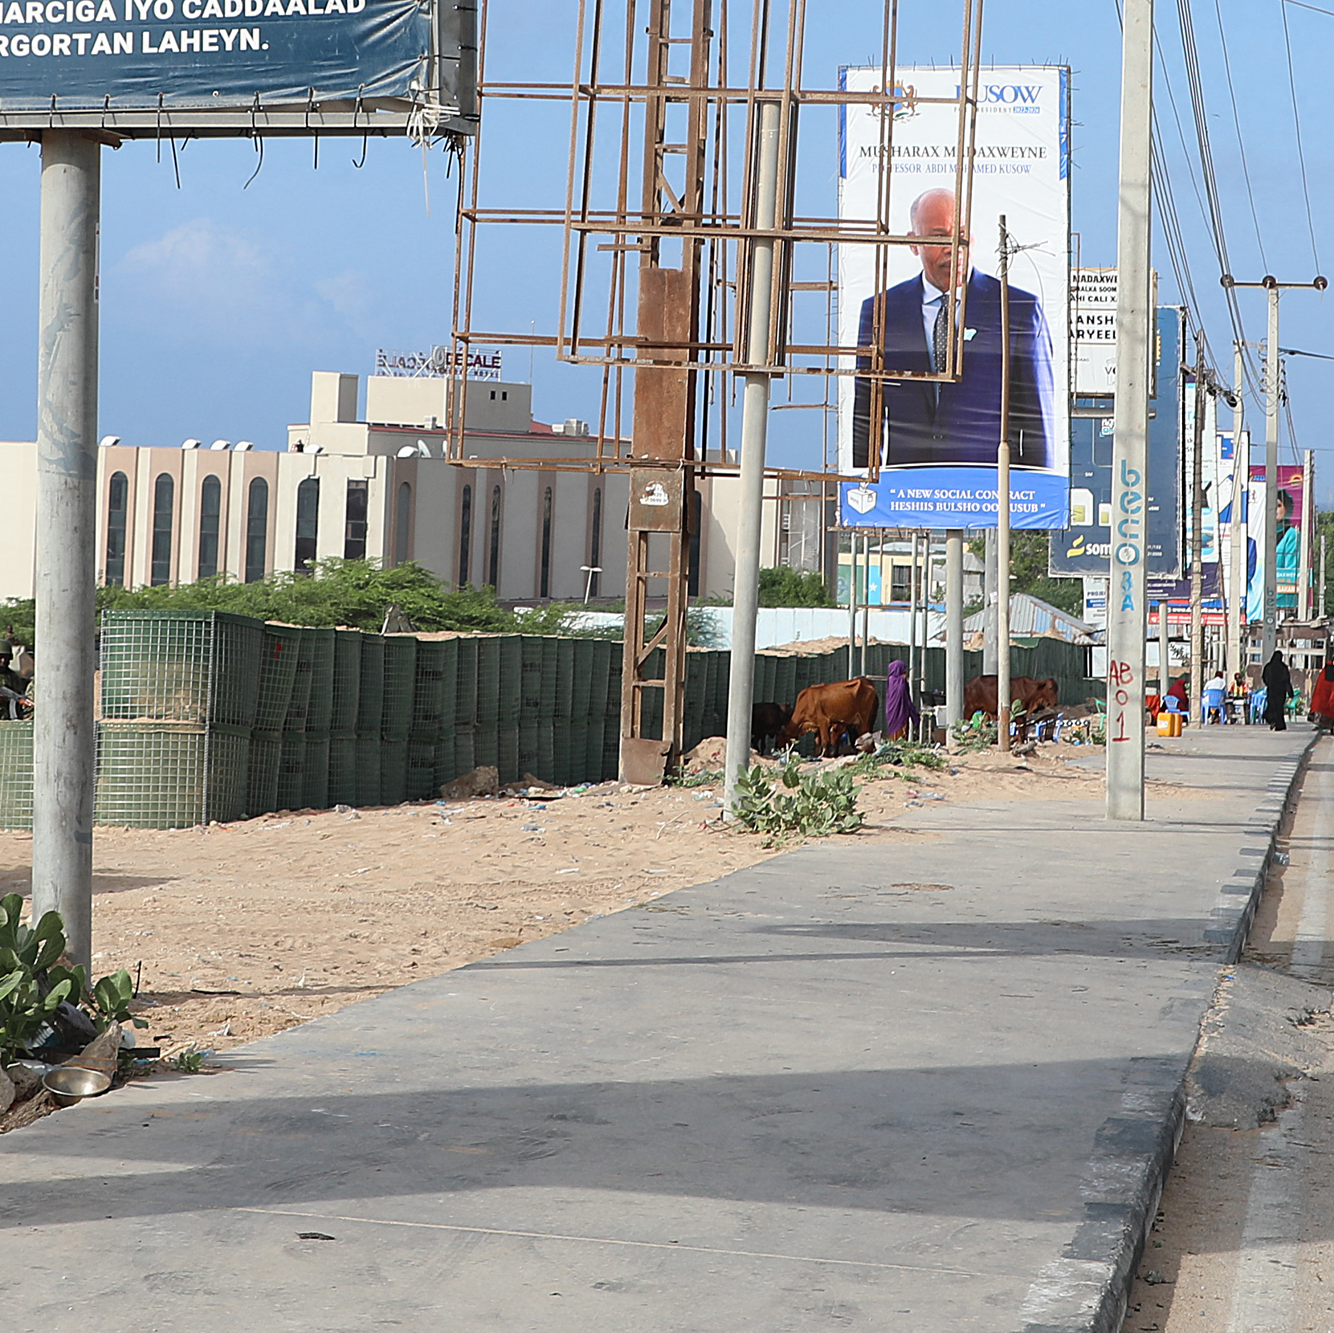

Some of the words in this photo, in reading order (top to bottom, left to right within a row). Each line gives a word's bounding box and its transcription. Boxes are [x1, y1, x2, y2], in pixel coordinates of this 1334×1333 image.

[142, 27, 270, 54] LAHEYN.
[944, 146, 1047, 159] MDAXWEYNE
[925, 164, 947, 173] ABDI
[999, 164, 1031, 174] KUSOW
[897, 489, 906, 499] A
[907, 489, 933, 499] NEW
[934, 489, 974, 500] SOCIAL
[975, 489, 1035, 500] CONRACT
[890, 502, 934, 512] HESHIIS
[936, 502, 980, 513] BULSHO
[1008, 503, 1039, 513] USUB
